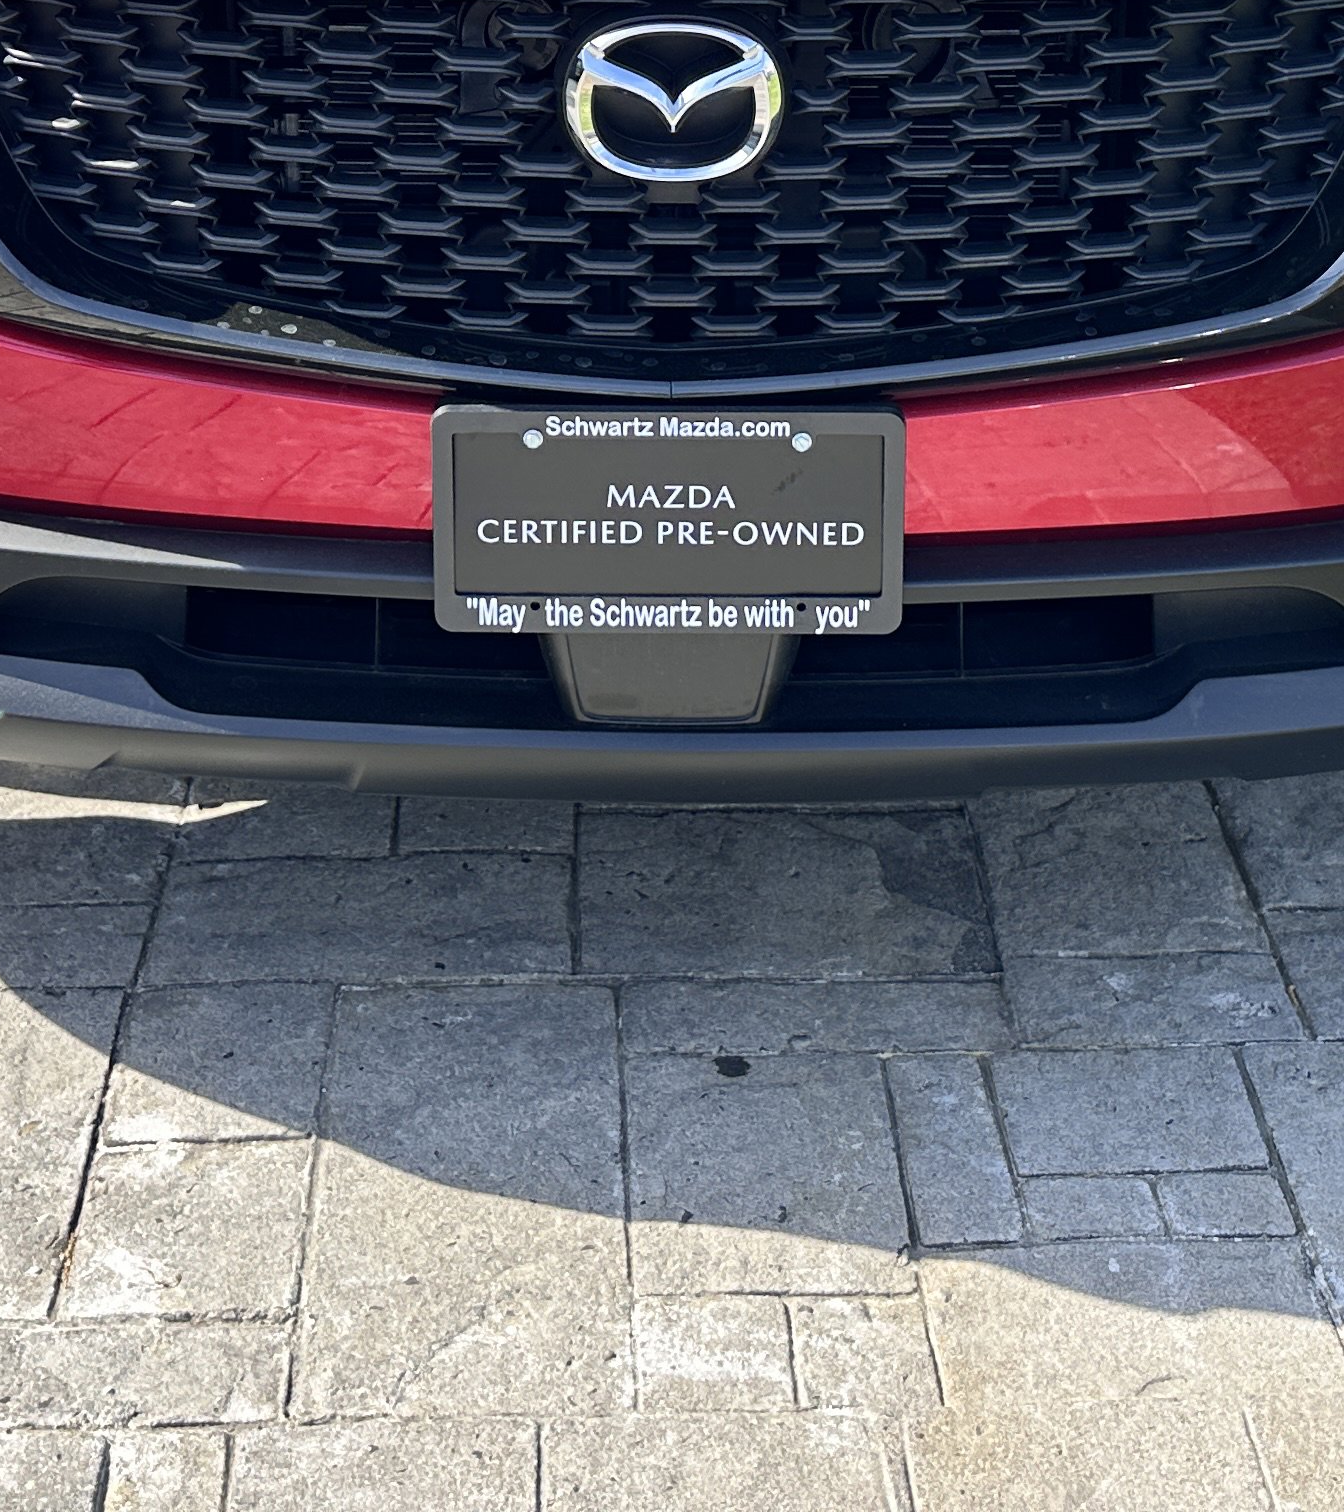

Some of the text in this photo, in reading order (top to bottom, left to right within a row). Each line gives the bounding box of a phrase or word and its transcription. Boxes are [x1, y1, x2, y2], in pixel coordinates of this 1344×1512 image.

[545, 416, 791, 439] Schwartz Mazda.com
[606, 484, 737, 509] MAZDA
[477, 519, 865, 547] CERTIFIED PRE-OWNED
[466, 597, 871, 635] "May the Schwartz be with you"
